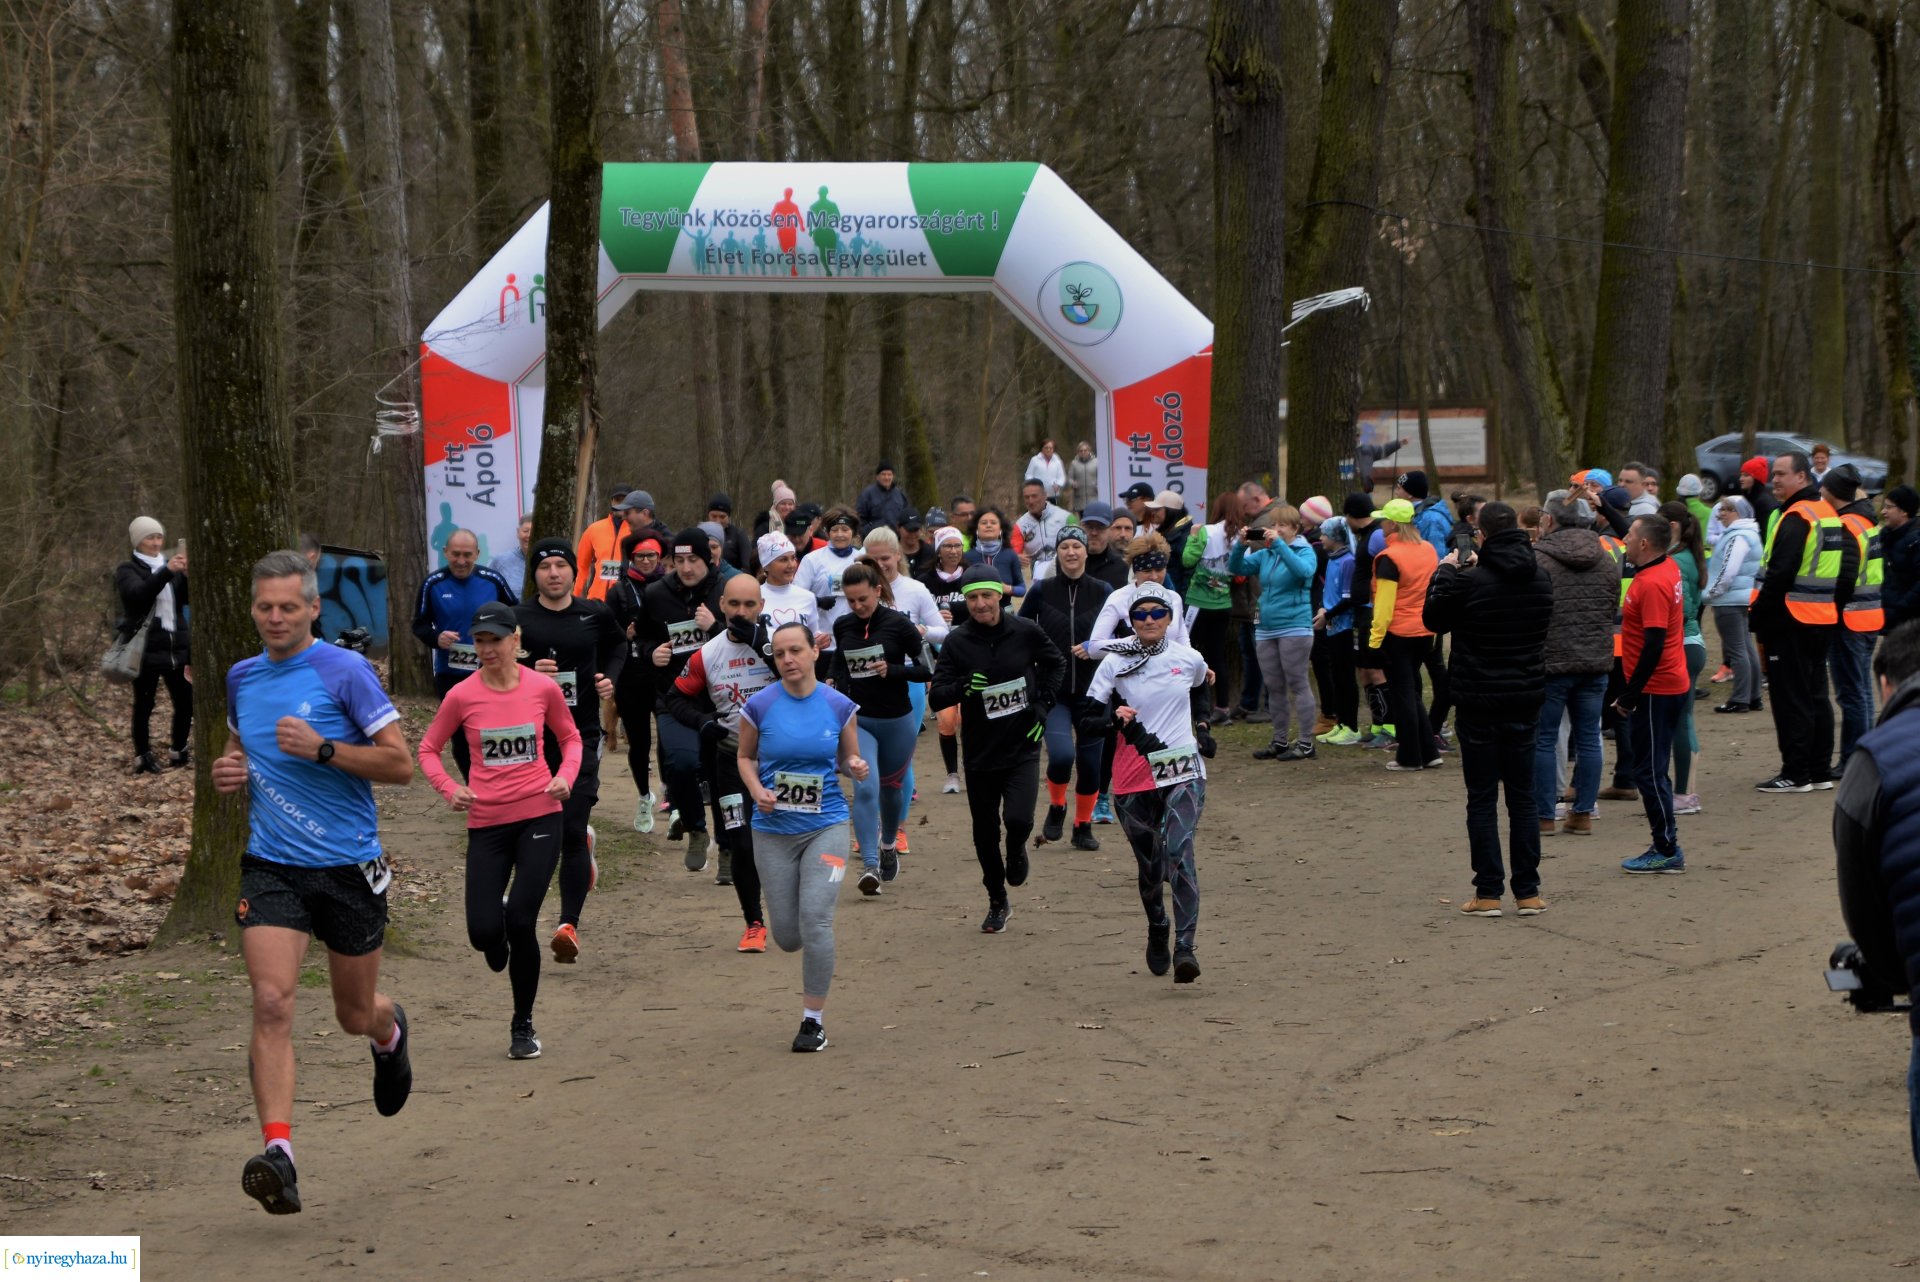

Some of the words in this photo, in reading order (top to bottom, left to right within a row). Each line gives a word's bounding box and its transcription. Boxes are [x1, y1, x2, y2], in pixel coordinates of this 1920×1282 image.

[619, 207, 706, 231] Tegyünk
[713, 208, 799, 228] Közösen
[807, 210, 984, 233] Magyarországért
[992, 210, 999, 230] !
[705, 243, 745, 265] Élet
[827, 248, 927, 268] Egyesület
[1128, 432, 1152, 477] Fitt
[1154, 391, 1185, 495] ondozó
[444, 442, 466, 488] Fitt
[466, 424, 501, 508] Ápoló
[672, 627, 703, 646] 220
[450, 650, 479, 664] 222
[986, 688, 1022, 712] 204
[485, 736, 527, 758] 200
[1154, 755, 1193, 779] 212
[247, 757, 307, 822] ZALADÓK
[304, 819, 327, 838] SE
[776, 783, 818, 804] 205
